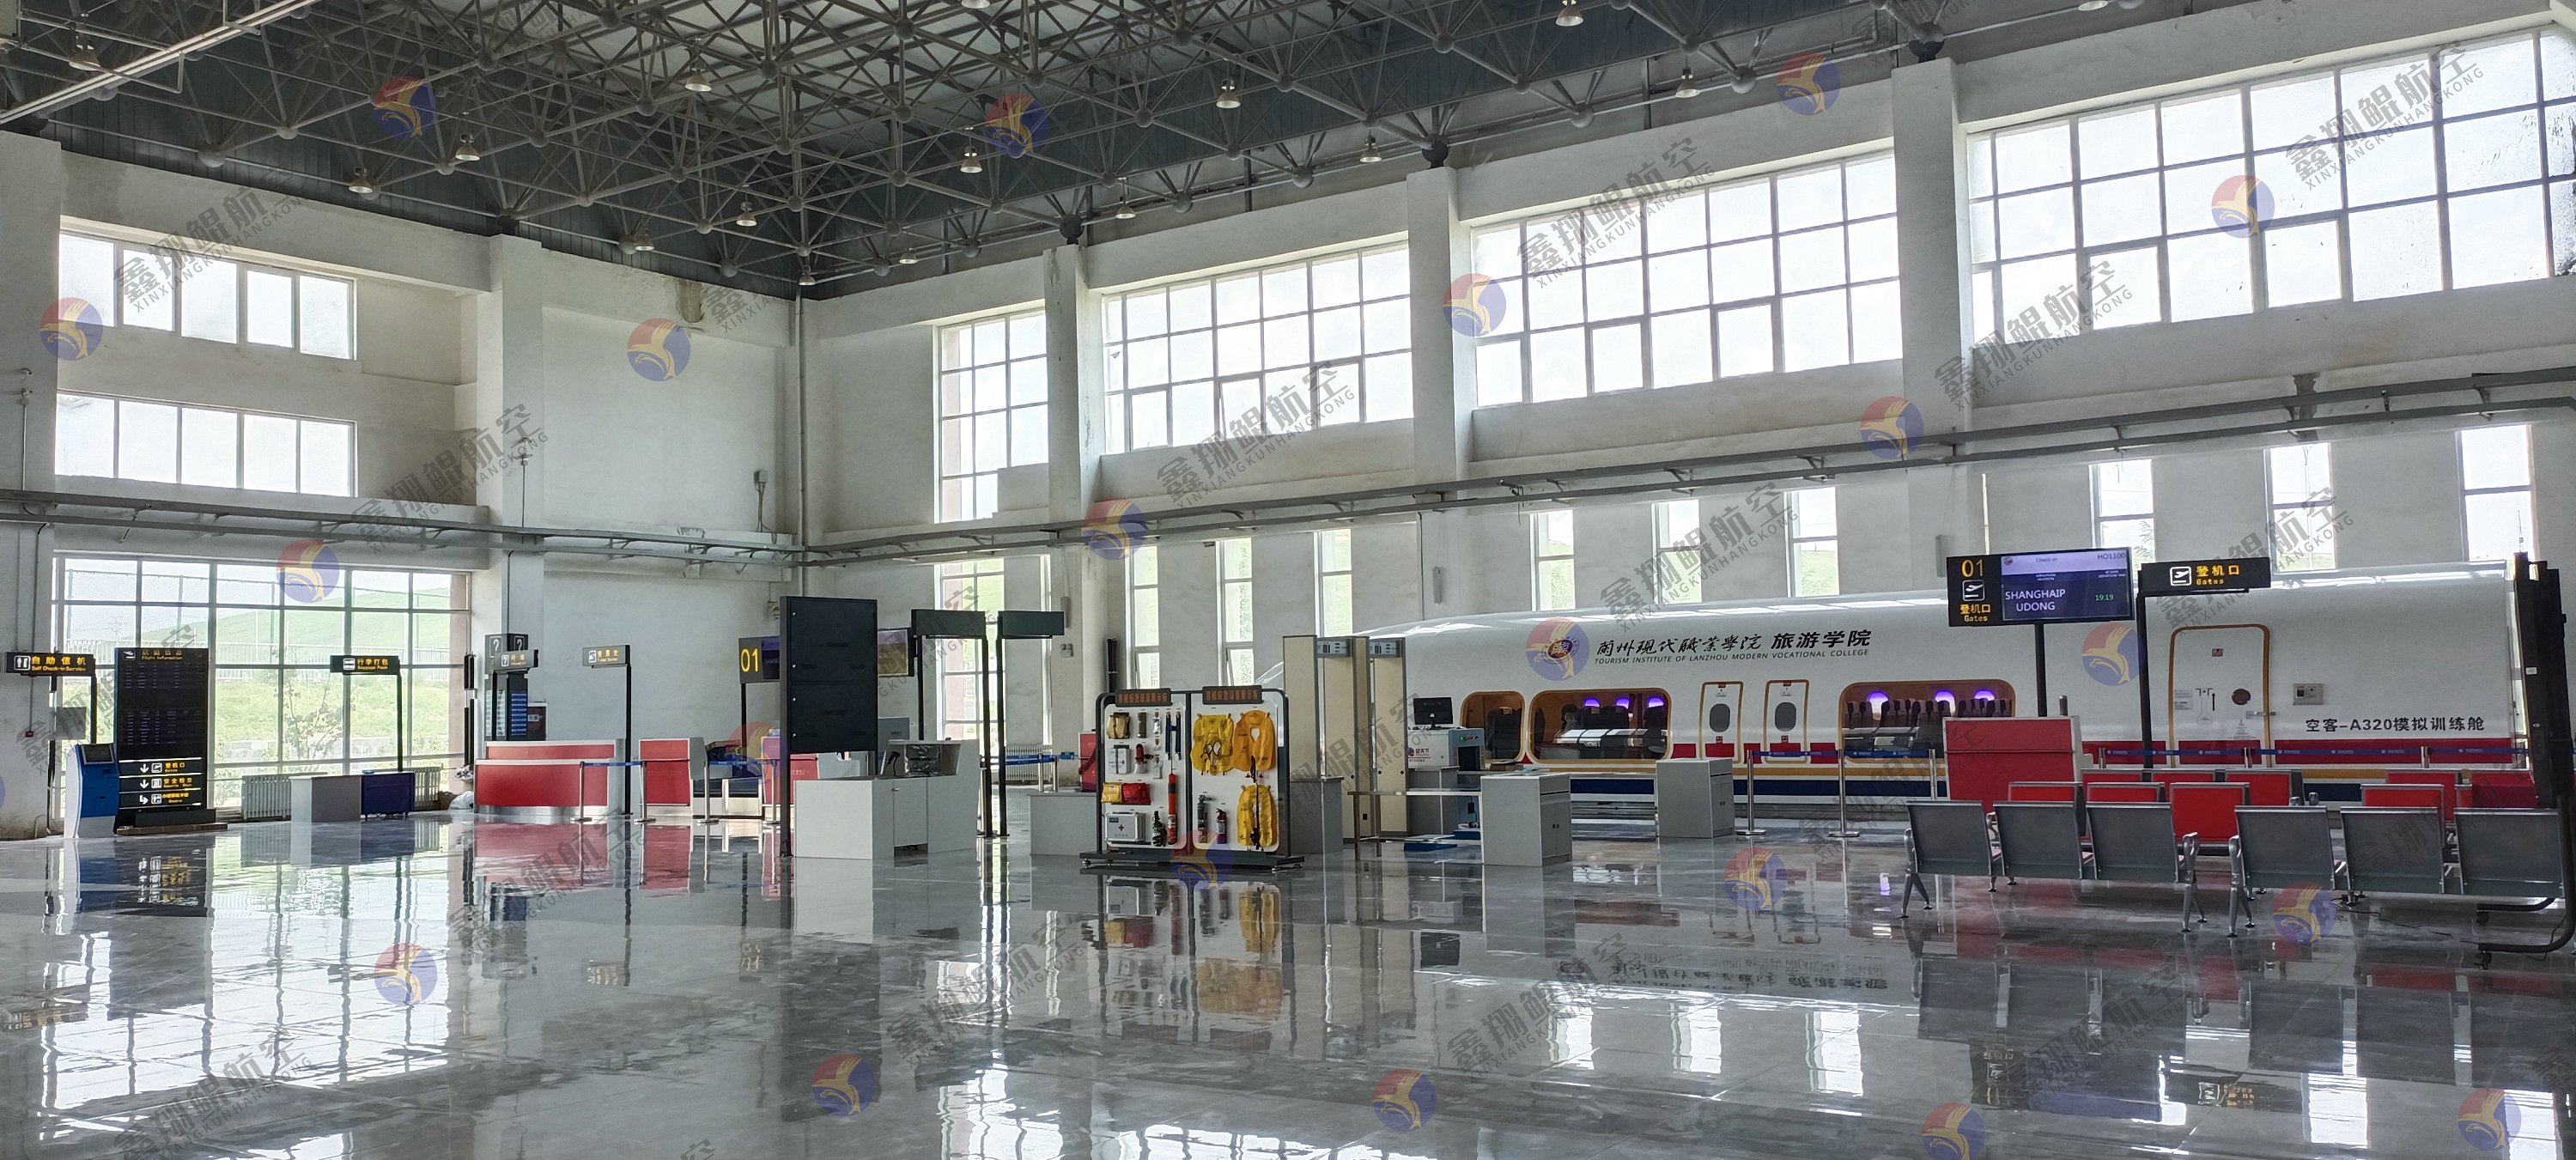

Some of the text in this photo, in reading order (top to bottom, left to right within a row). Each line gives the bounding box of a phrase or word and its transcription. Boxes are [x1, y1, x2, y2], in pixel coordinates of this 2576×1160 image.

[1961, 559, 1984, 578] 01
[2196, 565, 2239, 577] 登机口
[2005, 589, 2065, 600] SHANGHAIP
[1959, 604, 1991, 614] 登机口
[2016, 602, 2056, 612] UDONG
[1771, 629, 1872, 649] 旅游学院
[32, 656, 86, 665] 自助值机
[740, 648, 758, 672] 01
